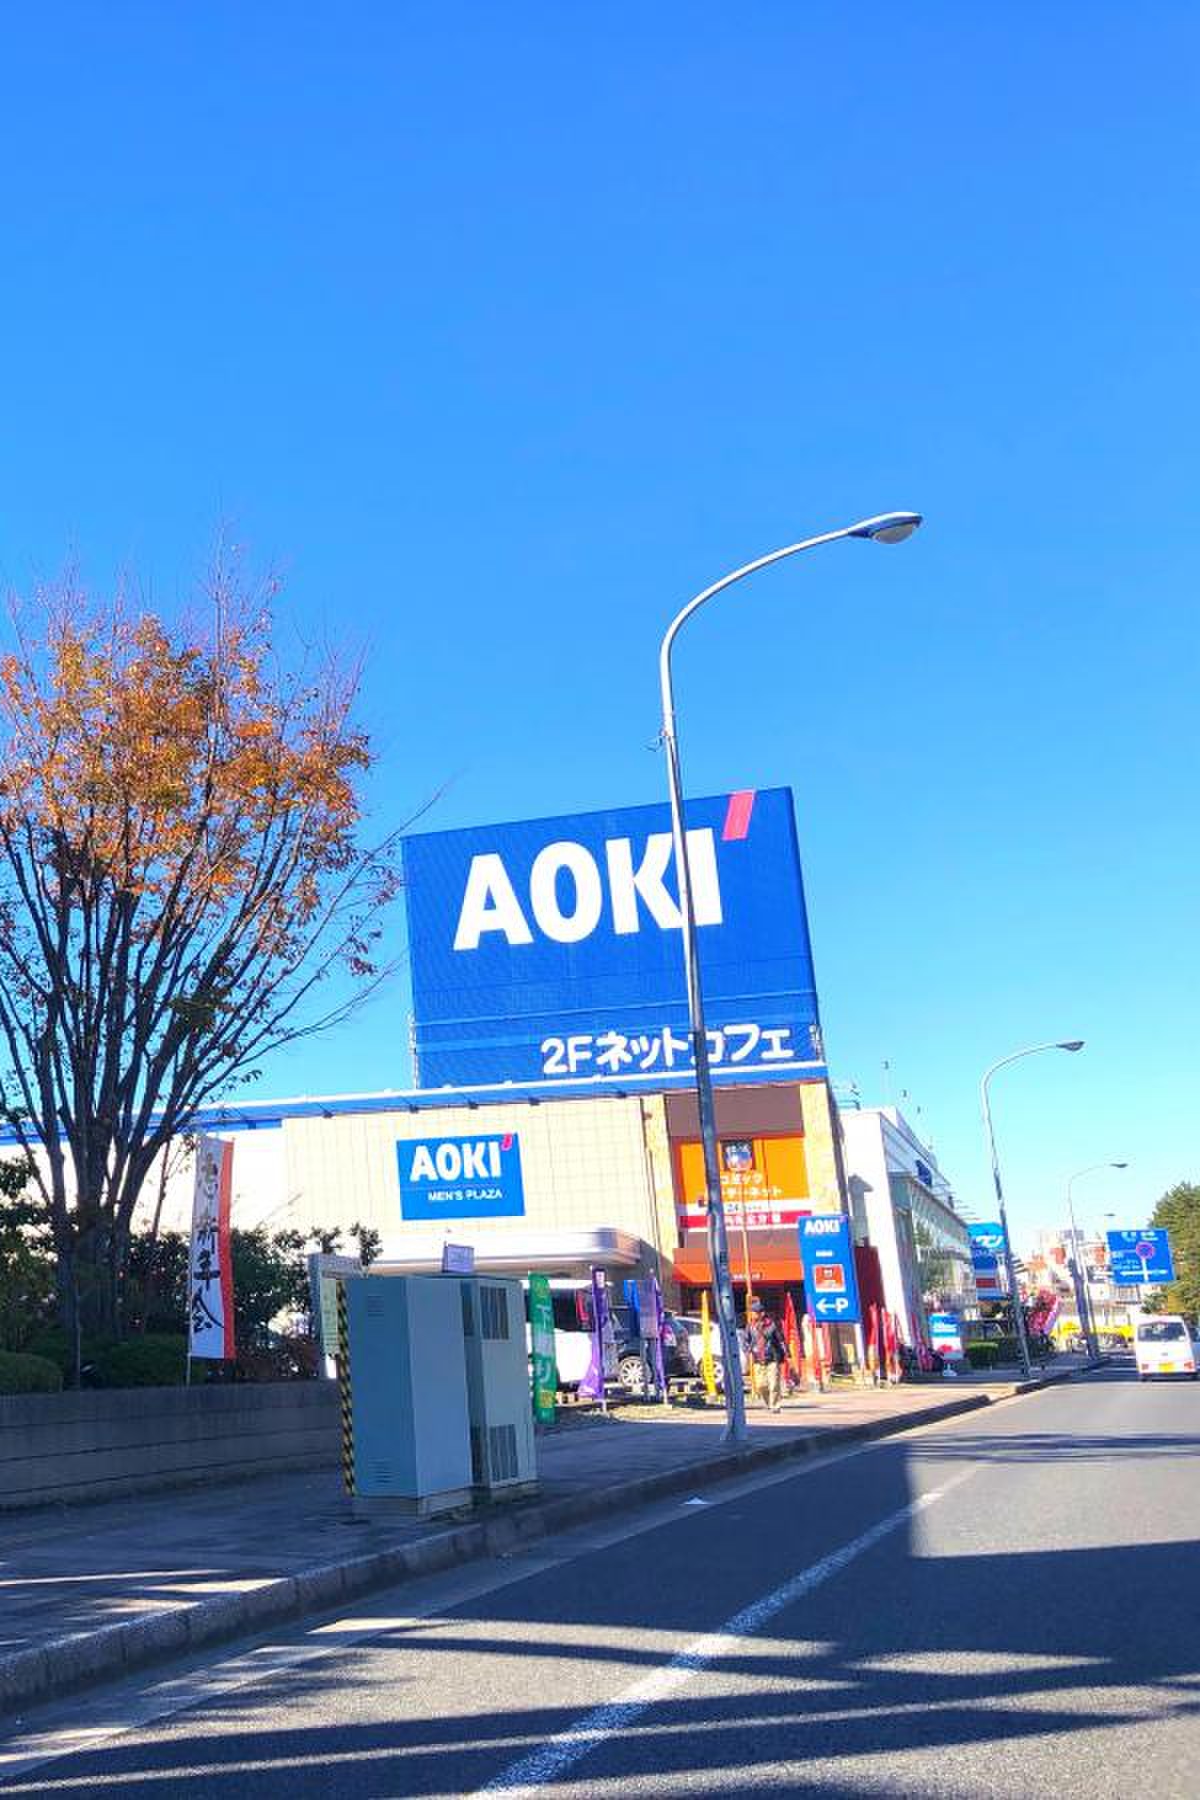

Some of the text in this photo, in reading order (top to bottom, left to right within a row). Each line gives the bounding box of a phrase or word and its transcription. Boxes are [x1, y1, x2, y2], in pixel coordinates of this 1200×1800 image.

[453, 828, 722, 951] AOKI
[409, 1140, 502, 1182] AOKI
[427, 1187, 503, 1202] MEN'S PLAZA
[804, 1219, 840, 1234] AOKI
